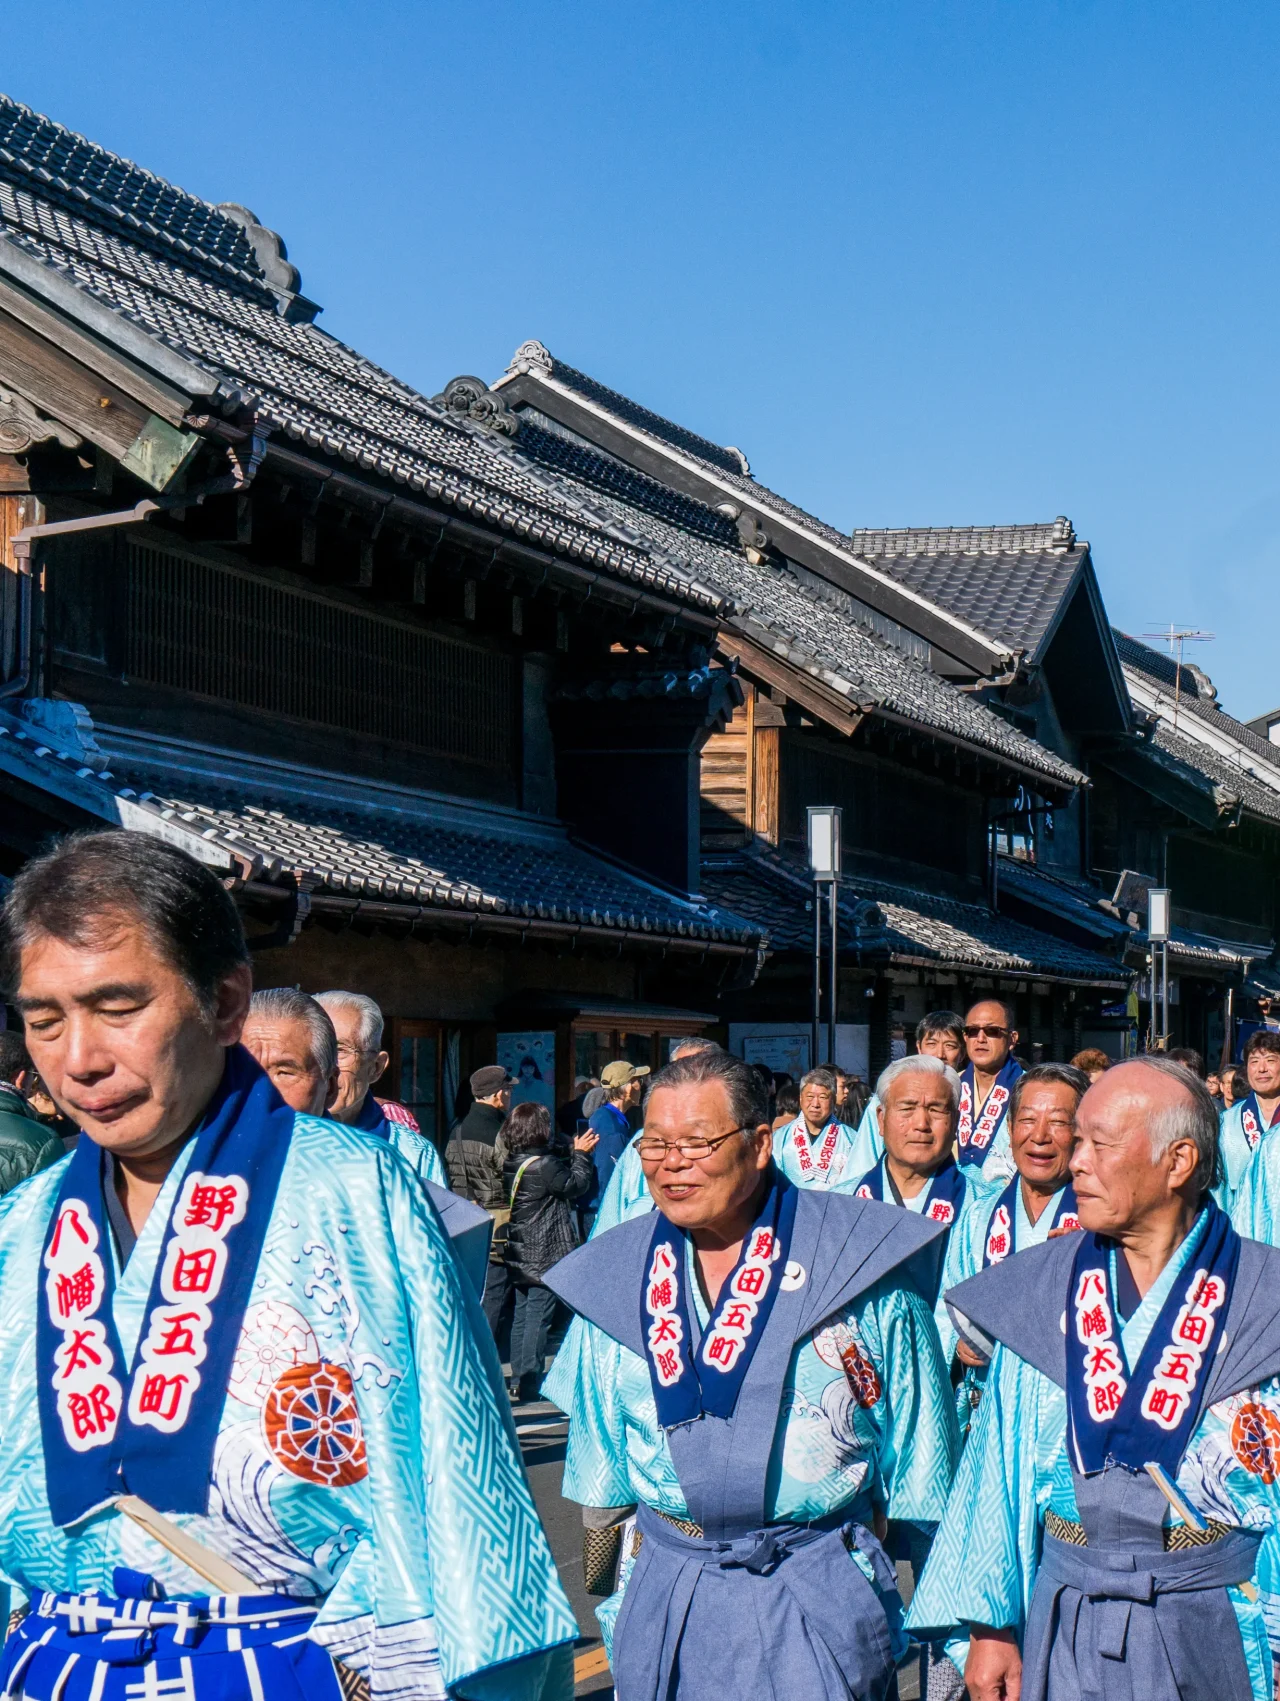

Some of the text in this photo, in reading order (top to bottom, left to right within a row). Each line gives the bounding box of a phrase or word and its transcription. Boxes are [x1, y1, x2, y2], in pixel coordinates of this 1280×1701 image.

[792, 1125, 813, 1171] 八幡太郎
[973, 1087, 1007, 1147] 野田五町
[49, 1208, 117, 1440] 八幡太郎
[138, 1182, 239, 1421] 野田五町
[650, 1247, 679, 1380] 八幡太郎
[1079, 1273, 1122, 1415] 八幡太郎
[1147, 1275, 1220, 1423] 野田五町
